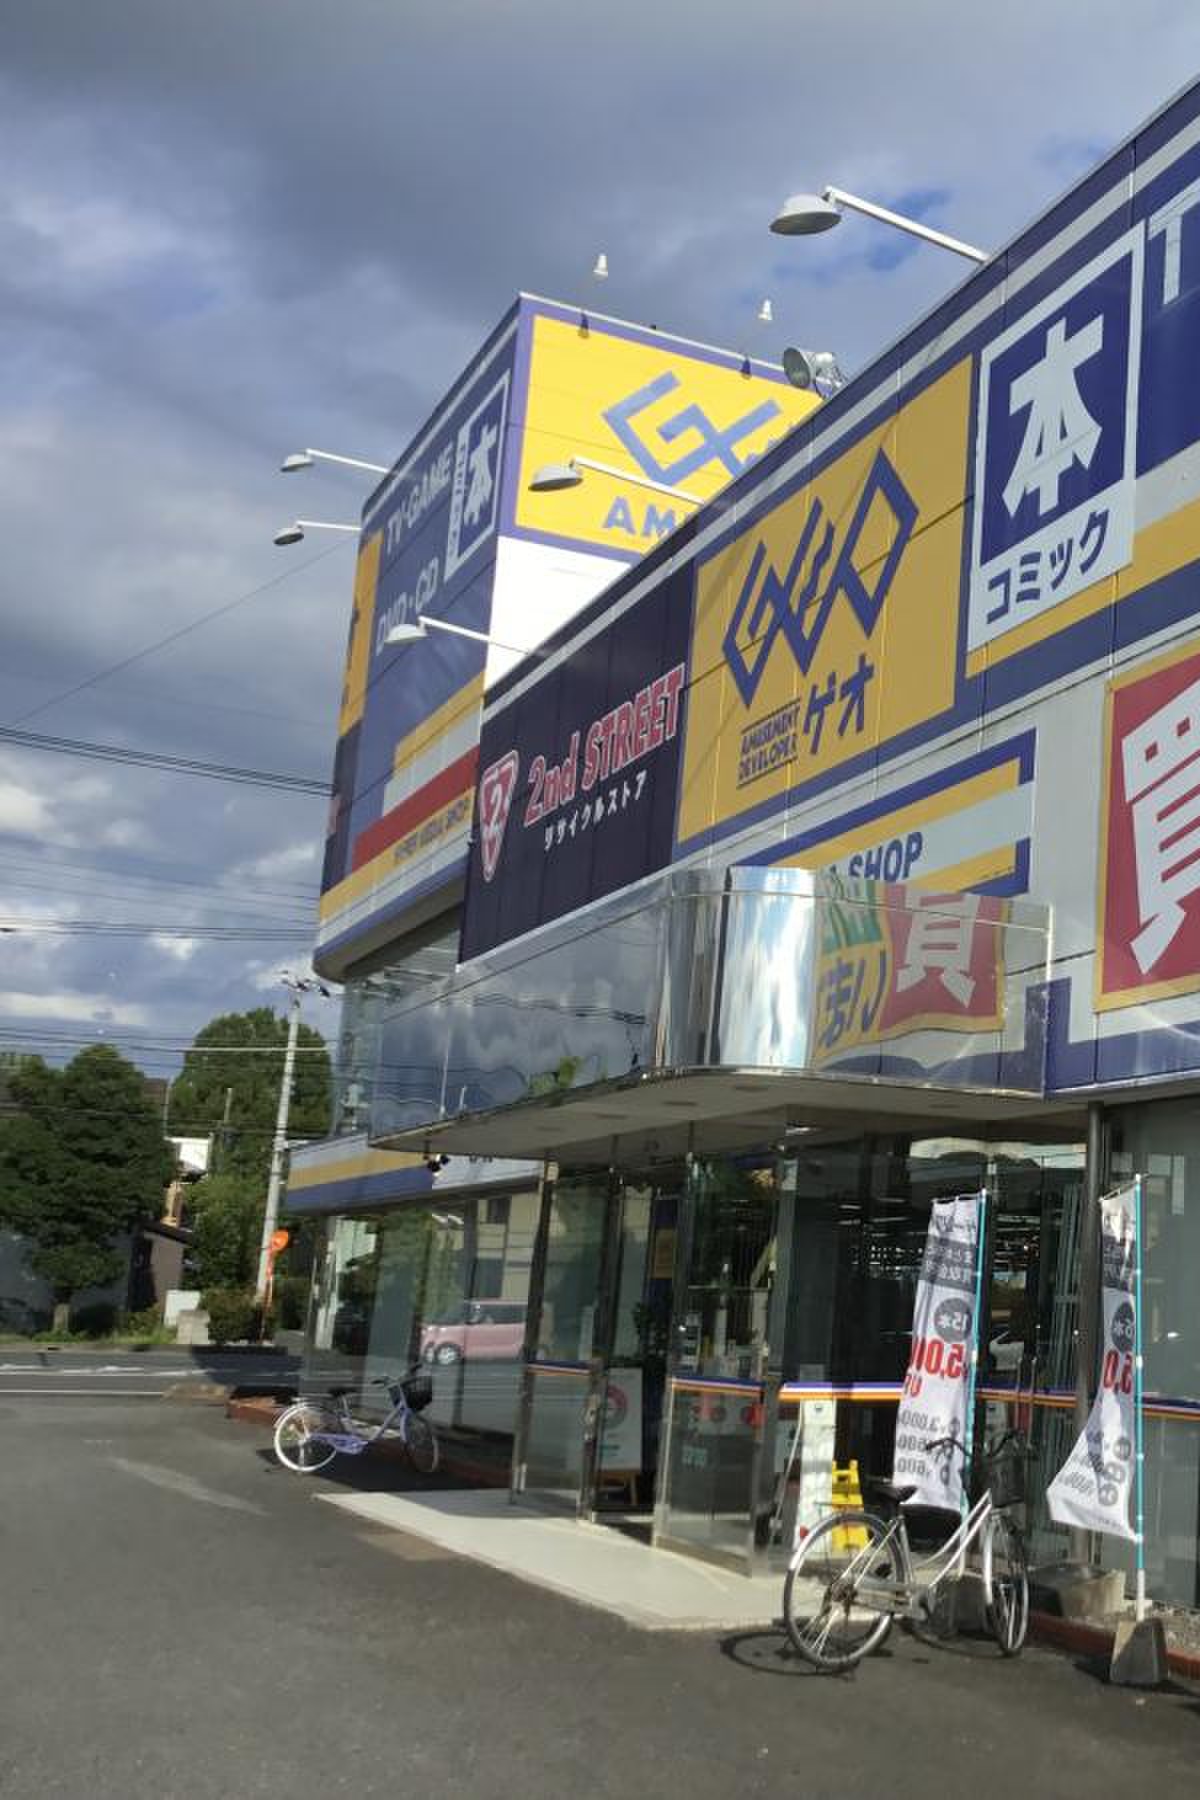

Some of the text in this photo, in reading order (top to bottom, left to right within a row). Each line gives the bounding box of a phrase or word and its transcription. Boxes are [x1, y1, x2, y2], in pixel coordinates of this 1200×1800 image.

[1002, 313, 1104, 519] 本
[986, 509, 1110, 626] コミック
[522, 731, 580, 828] 2nd
[581, 661, 686, 791] STREET
[803, 652, 876, 756] ゲオ
